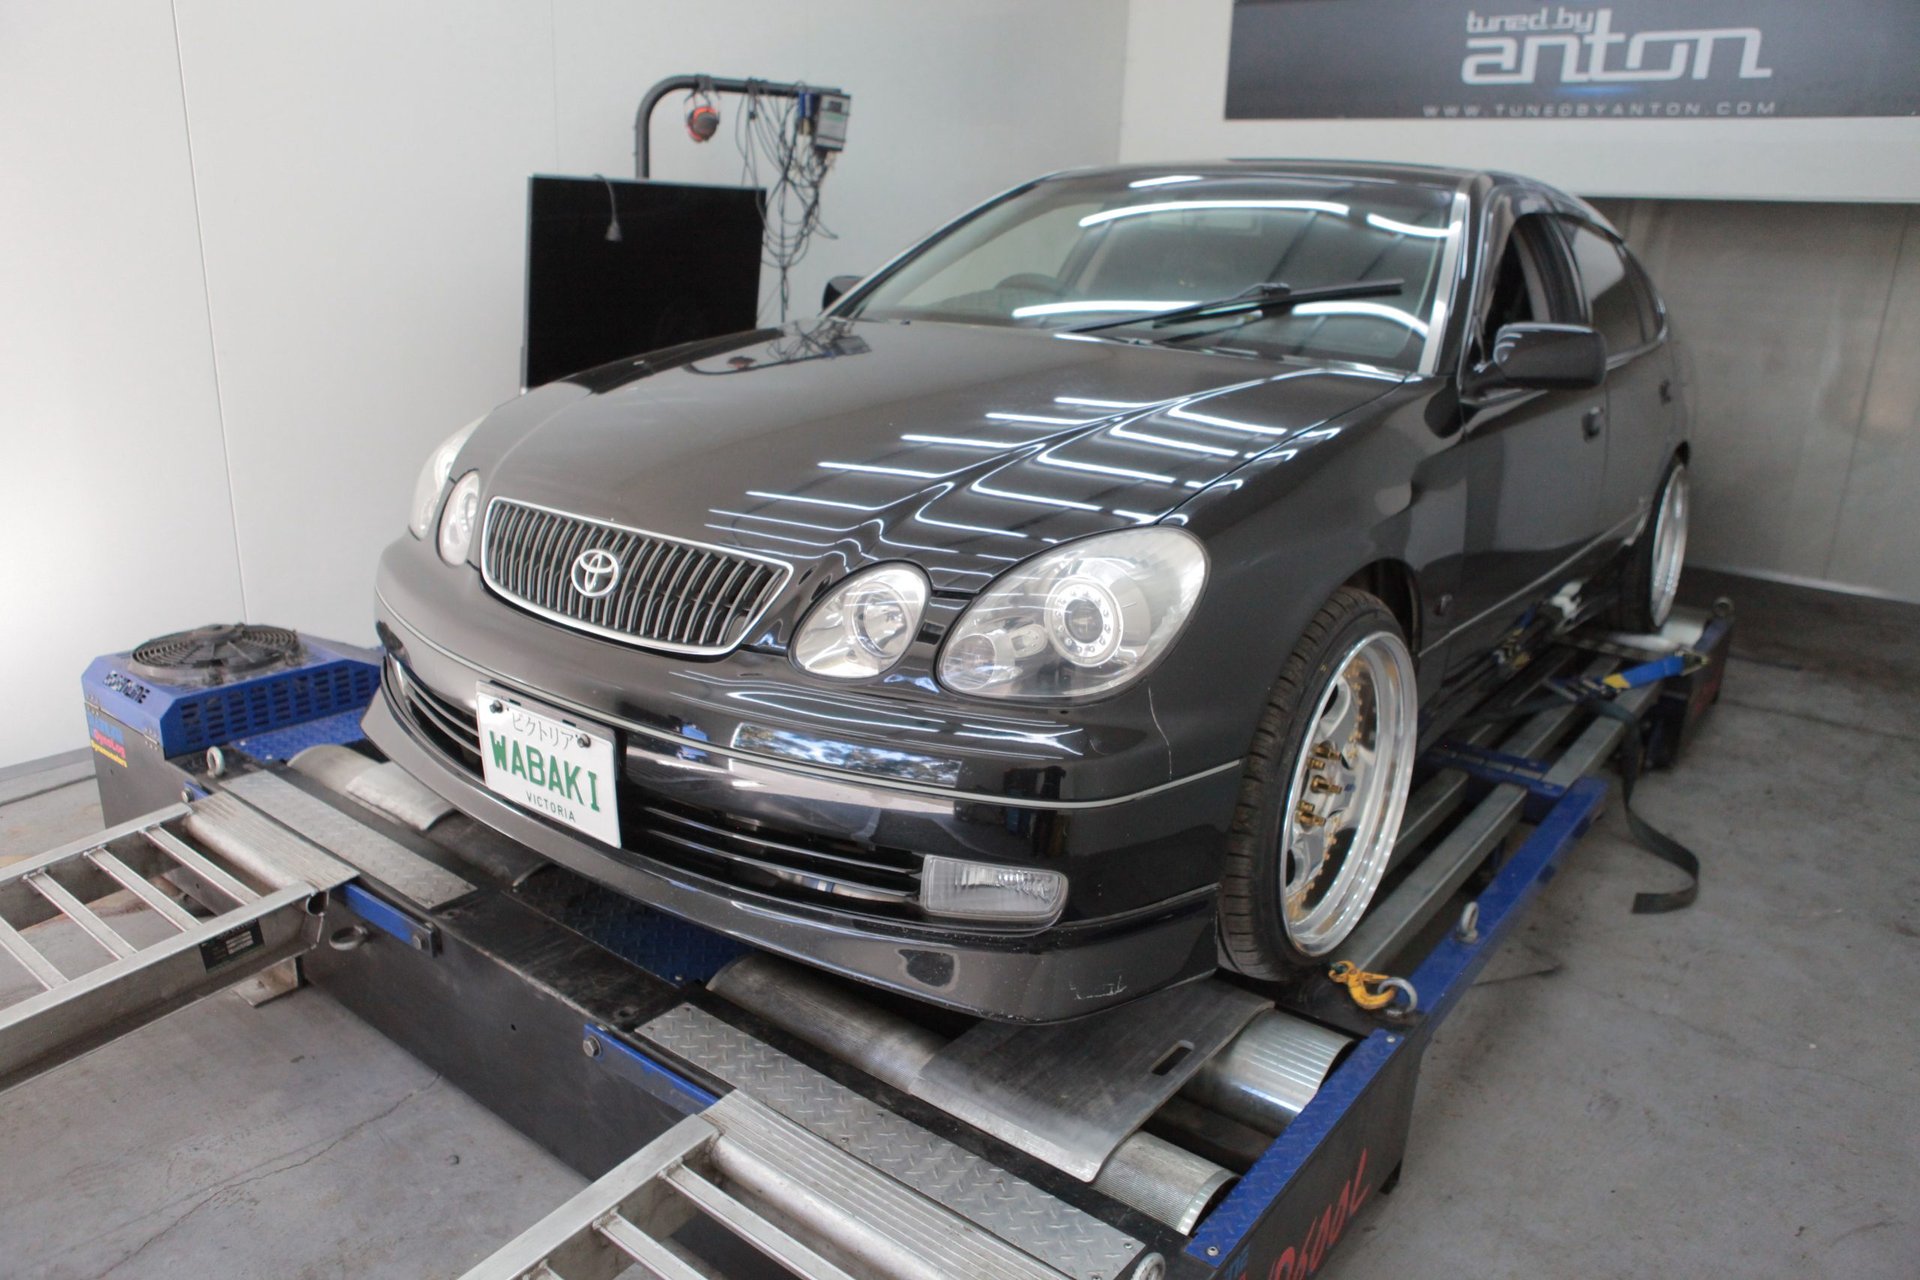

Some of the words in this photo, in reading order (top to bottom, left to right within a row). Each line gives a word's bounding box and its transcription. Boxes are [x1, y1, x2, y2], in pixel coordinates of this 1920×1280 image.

[1466, 7, 1549, 34] tuned
[1552, 6, 1595, 34] by
[1461, 8, 1773, 85] anton
[511, 711, 575, 751] ビクトリア
[488, 730, 601, 813] WABAKI
[525, 791, 577, 824] VICTORIA
